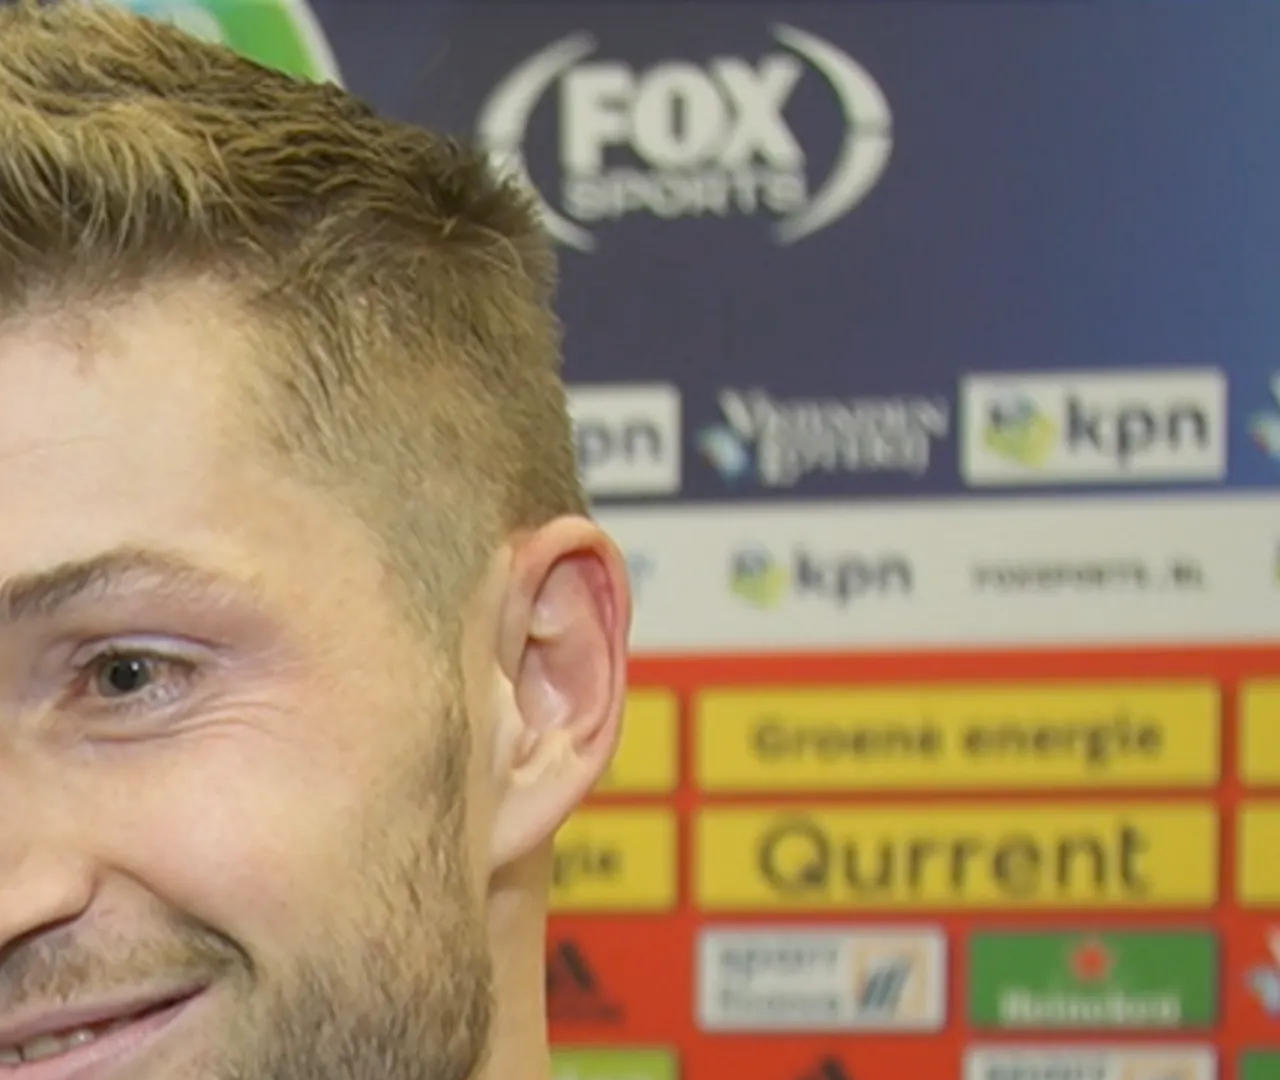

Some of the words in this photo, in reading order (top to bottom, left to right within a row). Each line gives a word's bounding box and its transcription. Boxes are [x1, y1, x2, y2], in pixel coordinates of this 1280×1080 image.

[560, 60, 803, 168] FOX
[563, 170, 806, 220] SPORTS
[578, 412, 665, 474] pn
[1065, 396, 1212, 468] kpn
[794, 545, 916, 608] kpn
[752, 723, 943, 759] Groene
[962, 718, 1163, 769] energie
[756, 818, 1152, 898] Qurrent
[719, 940, 838, 980] sport
[1000, 990, 1180, 1024] Heineken
